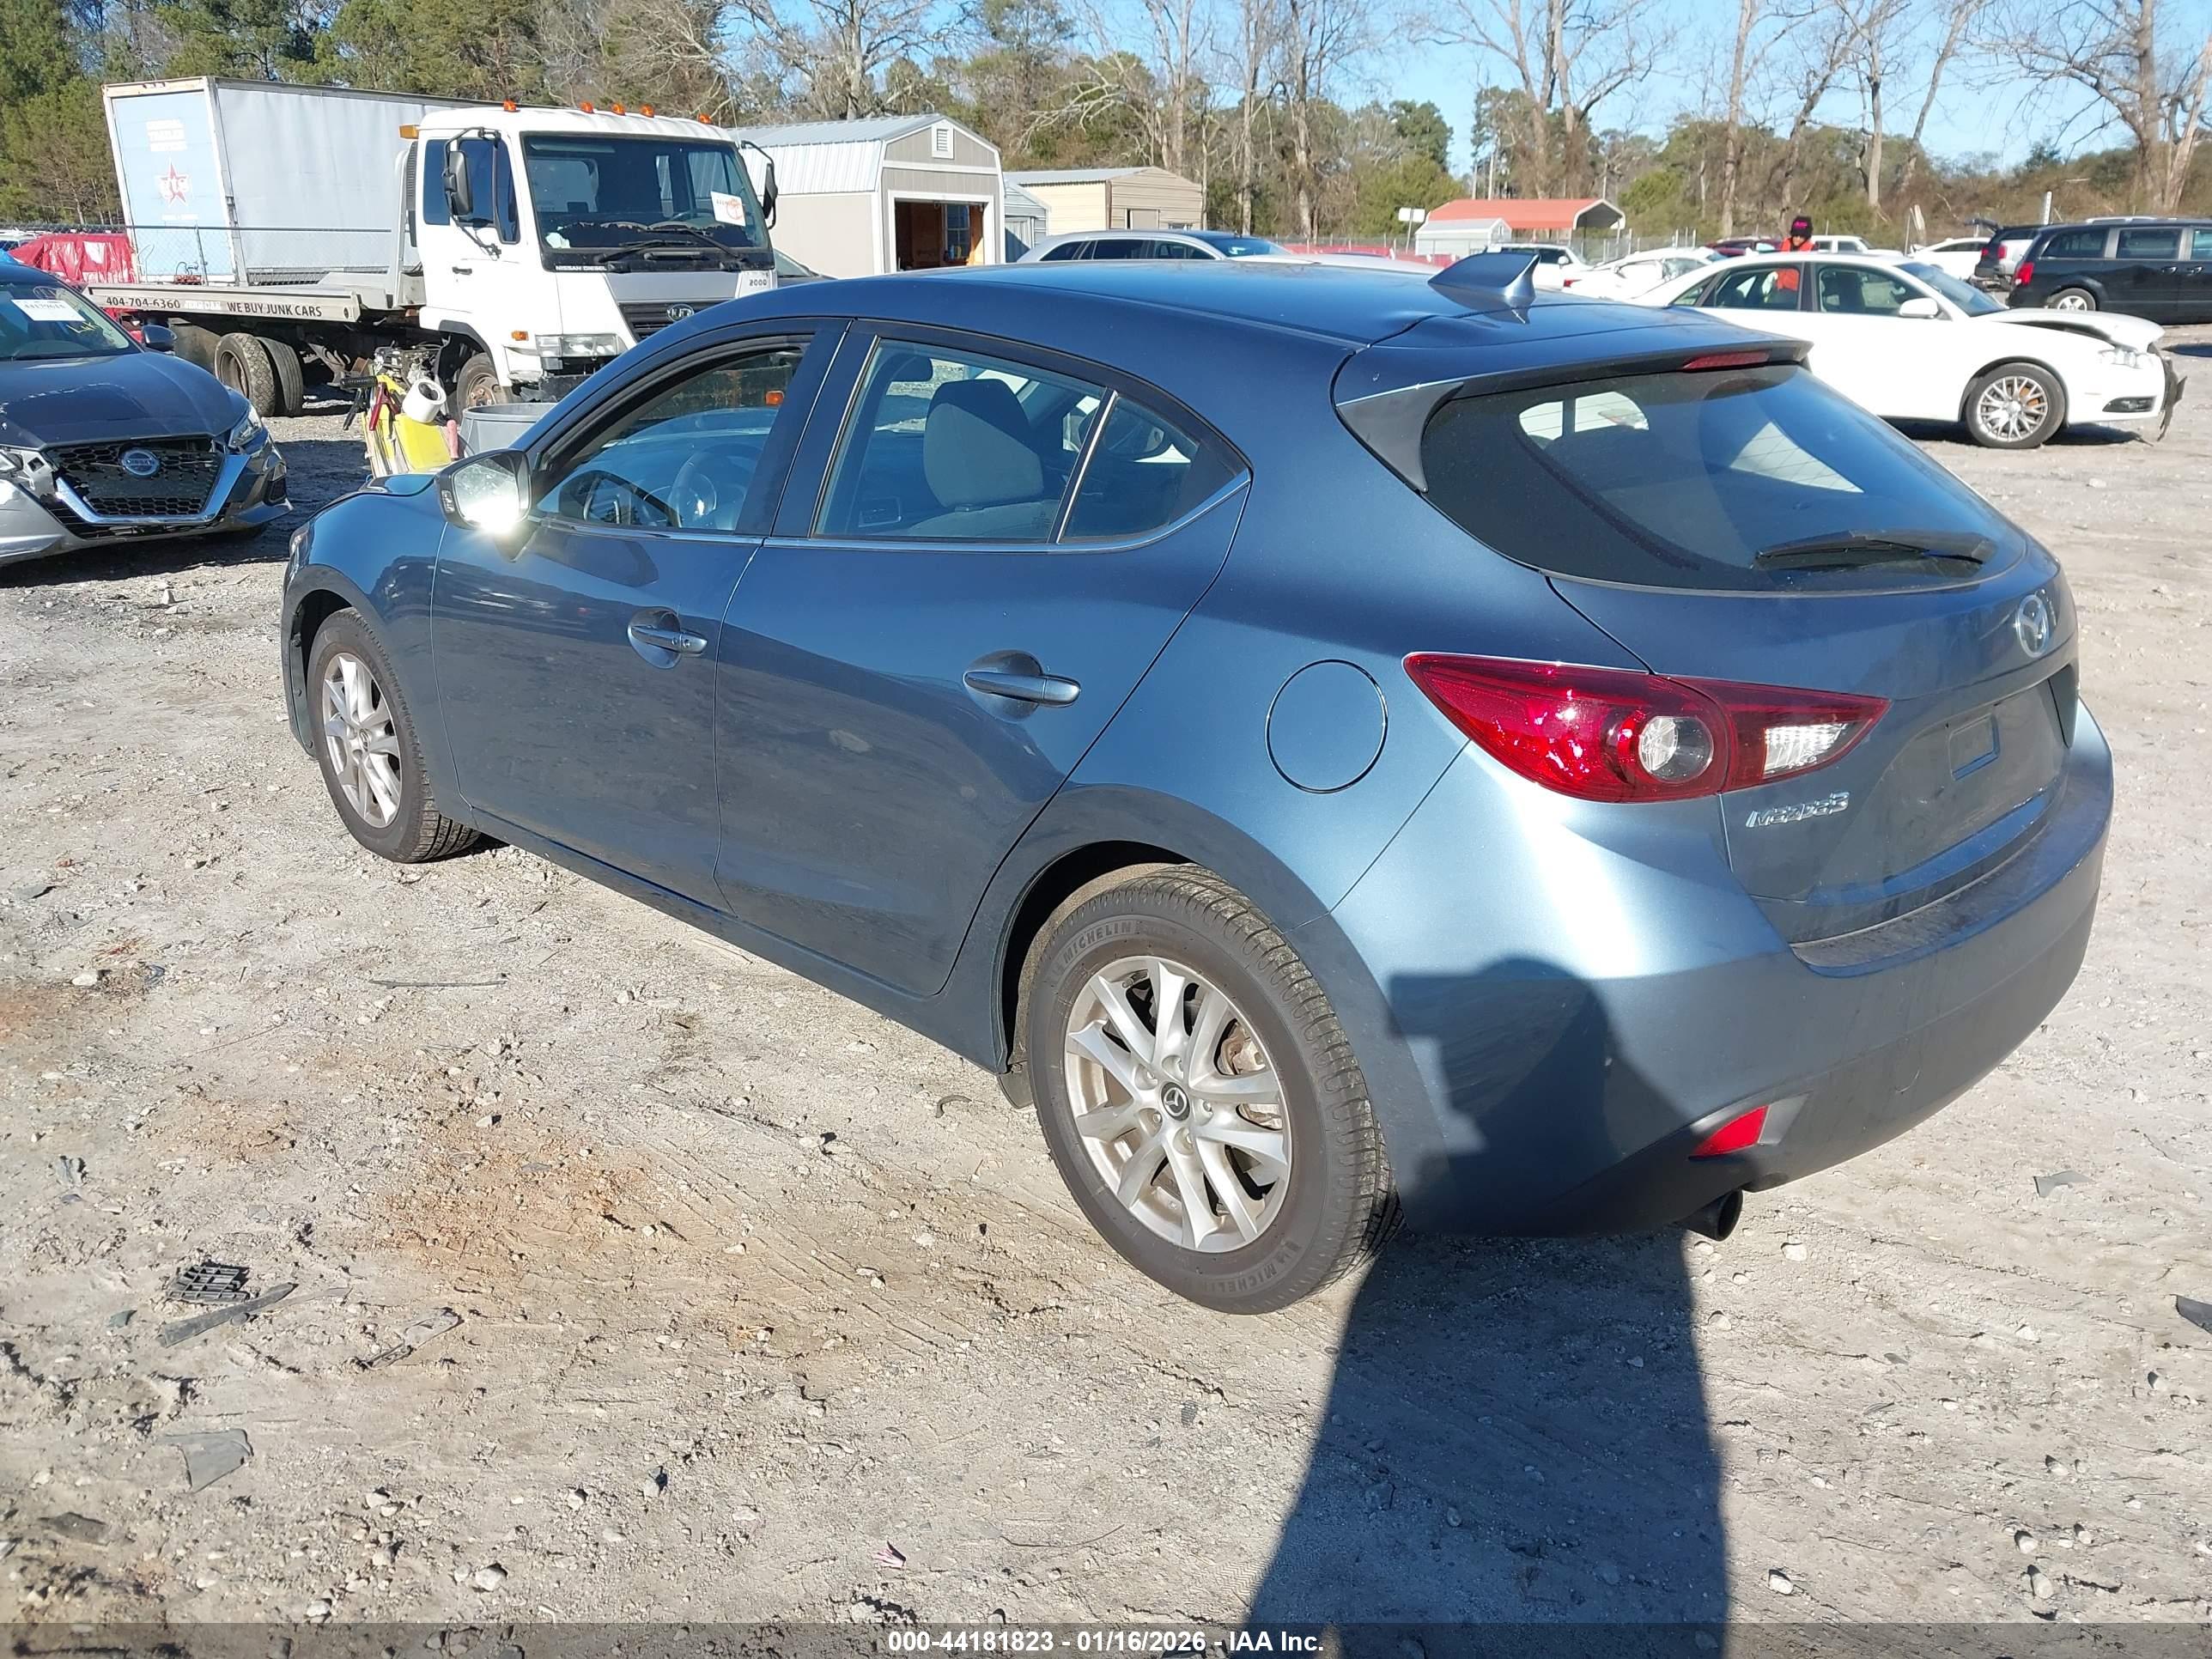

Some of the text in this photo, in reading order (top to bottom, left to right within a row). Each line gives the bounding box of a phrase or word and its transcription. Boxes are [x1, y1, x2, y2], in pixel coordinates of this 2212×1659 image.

[106, 295, 180, 309] 404-704-6360
[227, 301, 243, 313] WE
[245, 302, 264, 313] BUY
[266, 304, 294, 316] JUNK
[295, 305, 323, 318] CARS
[1063, 921, 1132, 963] MICHELIN
[1202, 1262, 1278, 1292] MICHELIN
